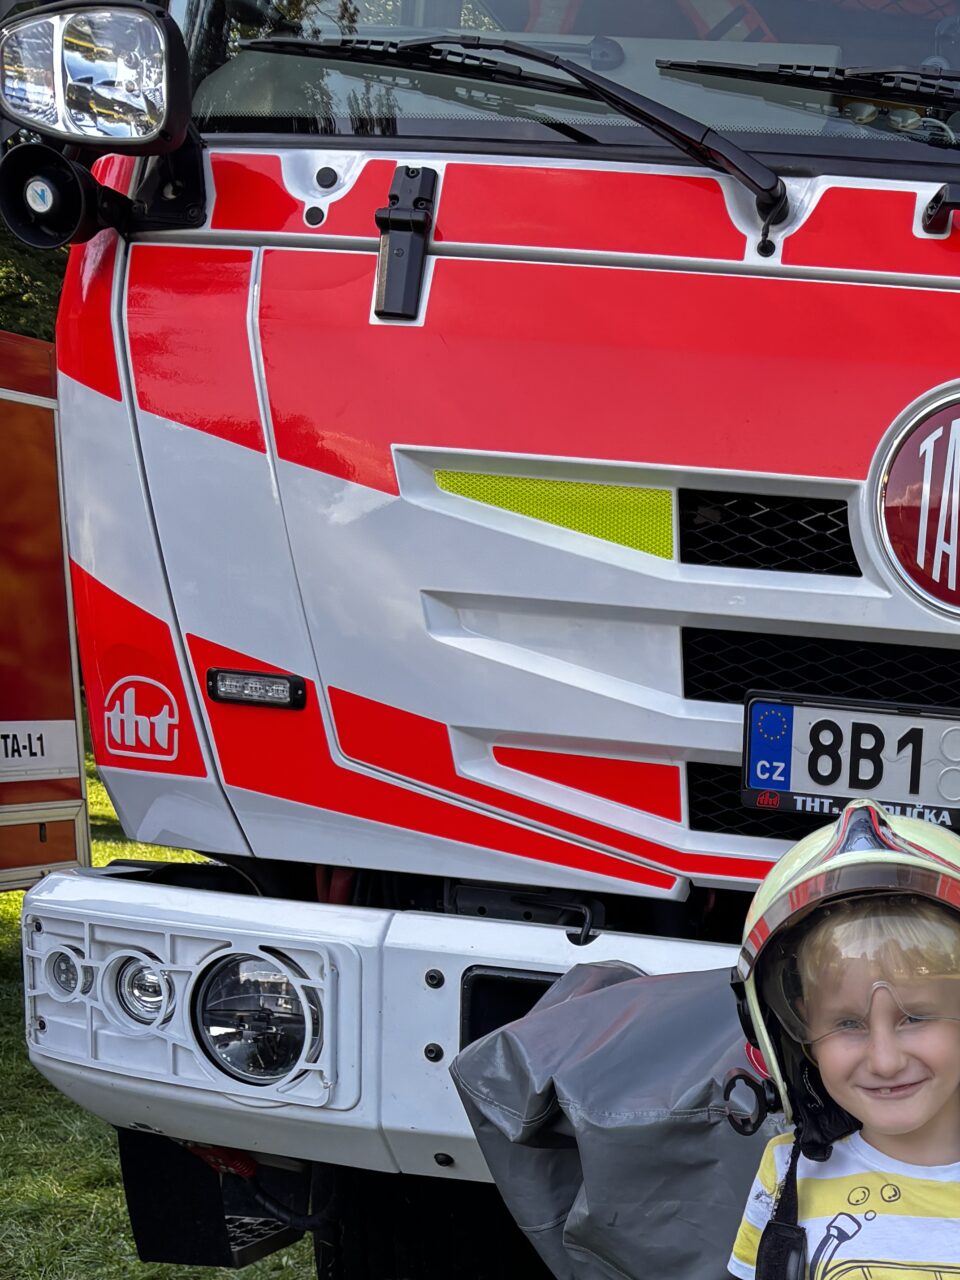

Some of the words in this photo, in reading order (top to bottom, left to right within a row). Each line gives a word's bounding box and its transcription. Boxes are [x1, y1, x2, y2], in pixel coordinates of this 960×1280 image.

[0, 733, 45, 758] TA-L1
[808, 719, 924, 795] 8B1
[756, 760, 785, 781] CZ
[882, 803, 952, 826] LIČKA
